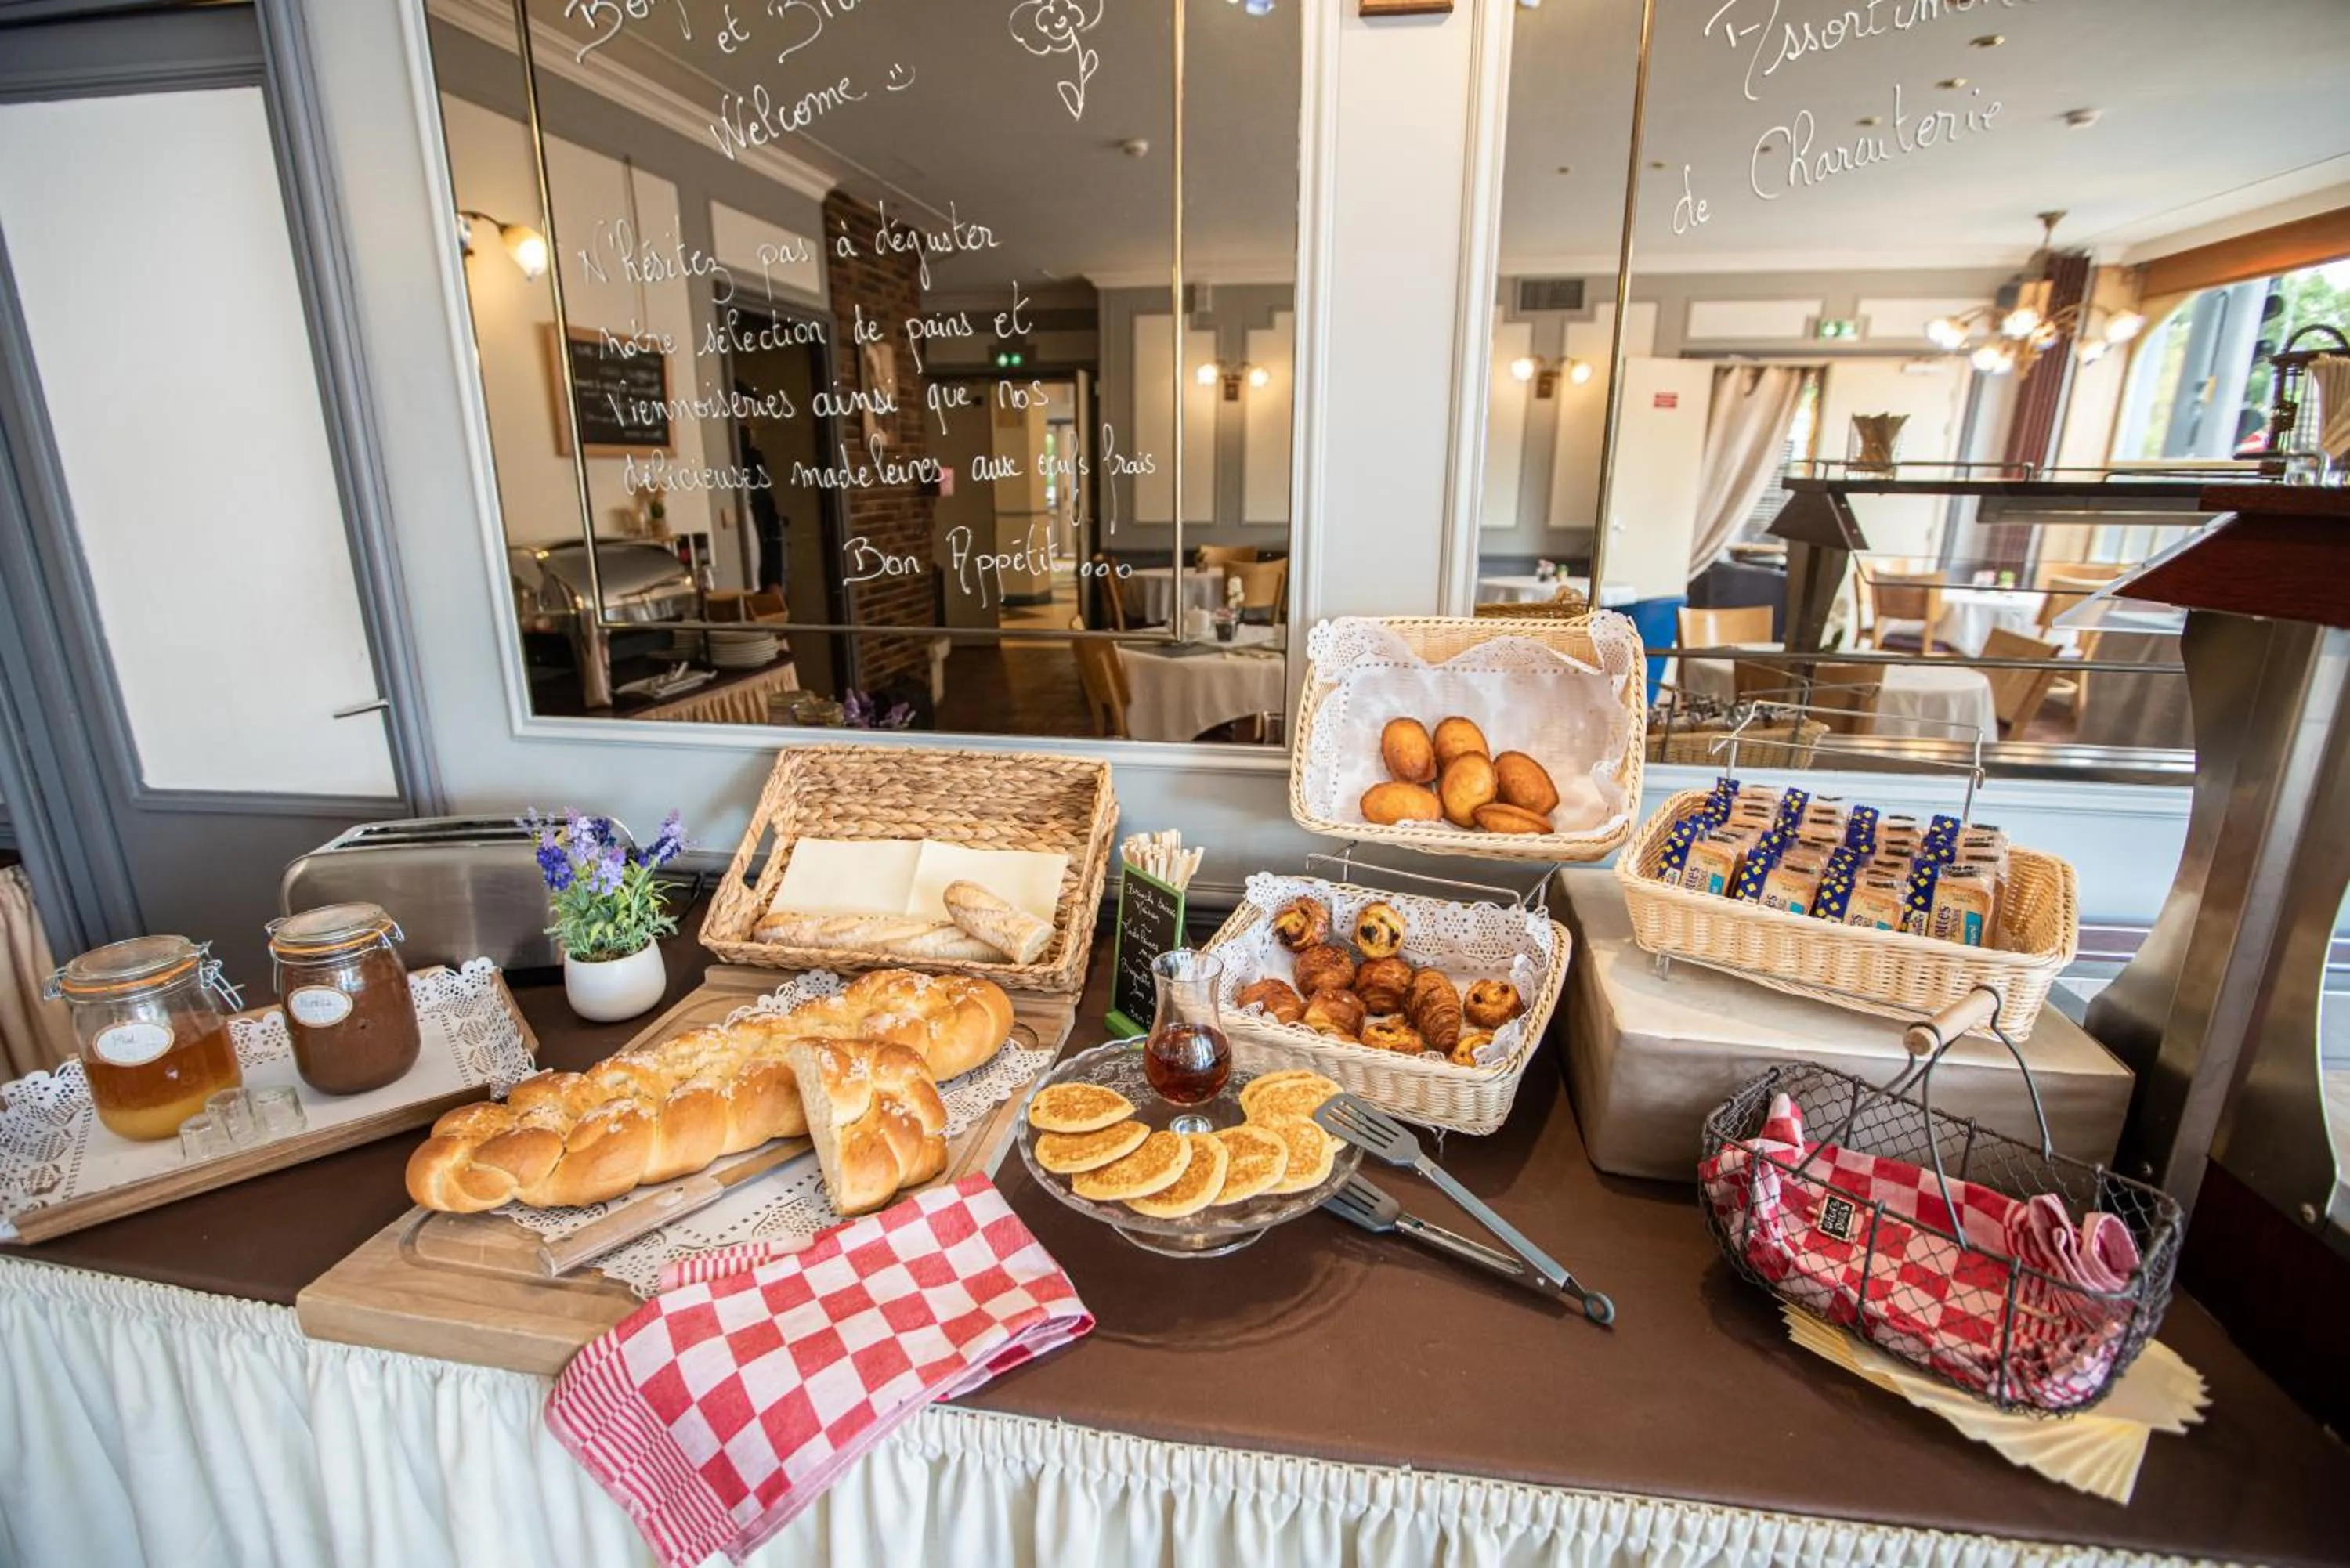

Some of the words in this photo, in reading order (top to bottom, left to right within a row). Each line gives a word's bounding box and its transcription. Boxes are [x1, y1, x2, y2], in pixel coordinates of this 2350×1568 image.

[717, 3, 750, 53] et
[710, 77, 868, 160] Welcome
[1673, 164, 1711, 234] de
[756, 237, 811, 302] pas
[837, 219, 859, 258] à
[875, 200, 1002, 291] déguster
[697, 308, 826, 356] sélection
[854, 303, 884, 345] de
[906, 311, 974, 374] pains
[993, 280, 1033, 338] et
[812, 378, 899, 418] ainsi
[927, 382, 971, 436] que
[790, 433, 946, 490] madeleines
[972, 454, 1023, 482] aux
[1101, 422, 1156, 535] frais
[843, 537, 921, 586] Bon
